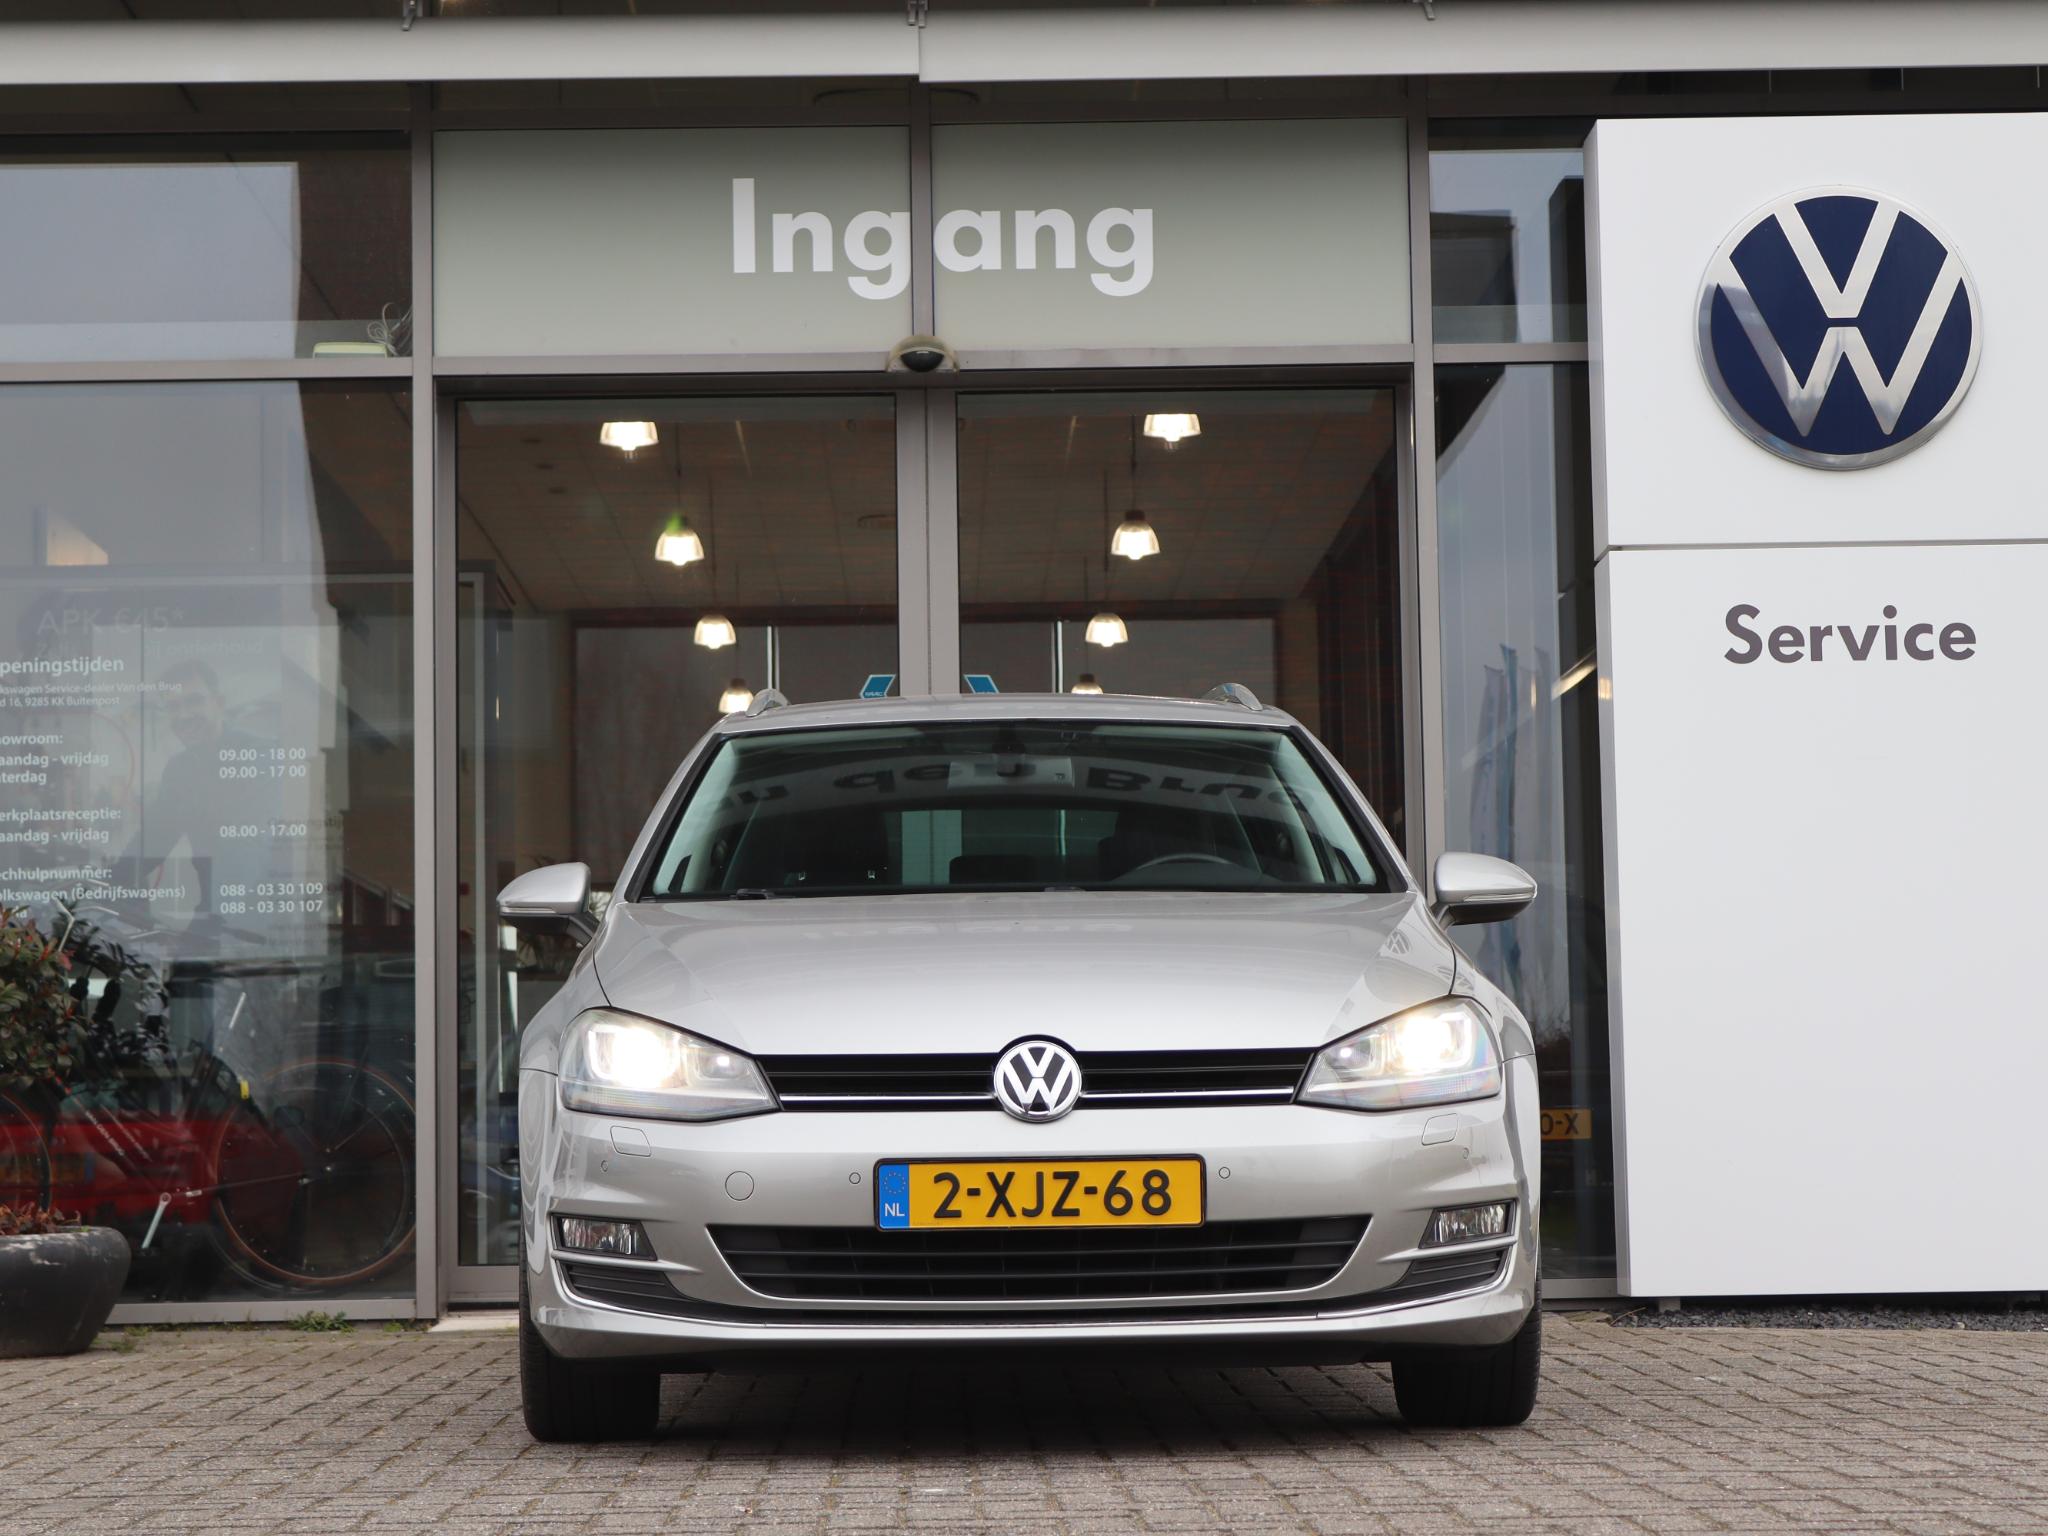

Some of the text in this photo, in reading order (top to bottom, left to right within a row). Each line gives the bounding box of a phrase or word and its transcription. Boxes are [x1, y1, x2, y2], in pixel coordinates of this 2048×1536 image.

[732, 177, 1154, 299] Ingang
[37, 609, 103, 635] APK
[1724, 604, 1977, 664] Service
[51, 696, 65, 707] KK
[66, 695, 120, 708] Buitenpost
[0, 734, 64, 746] owroom:
[60, 752, 109, 768] vrijdag
[219, 749, 257, 761] 09.00
[0, 769, 47, 786] terdag
[219, 766, 257, 779] 09.00
[61, 828, 109, 844] vrijdag
[220, 825, 257, 837] 08.00
[271, 824, 307, 836] 17.00
[0, 867, 112, 883] chhulpnummer:
[71, 886, 186, 902] (Bedrijfswagens)
[220, 884, 246, 896] 088
[257, 884, 274, 896] 03
[277, 883, 294, 895] 30
[299, 882, 324, 895] 109
[220, 902, 246, 914] 088
[257, 901, 274, 913] 03
[277, 901, 294, 913] 30
[299, 900, 323, 912] 107
[933, 1169, 1172, 1218] 2-XJZ-68
[884, 1203, 905, 1217] NL
